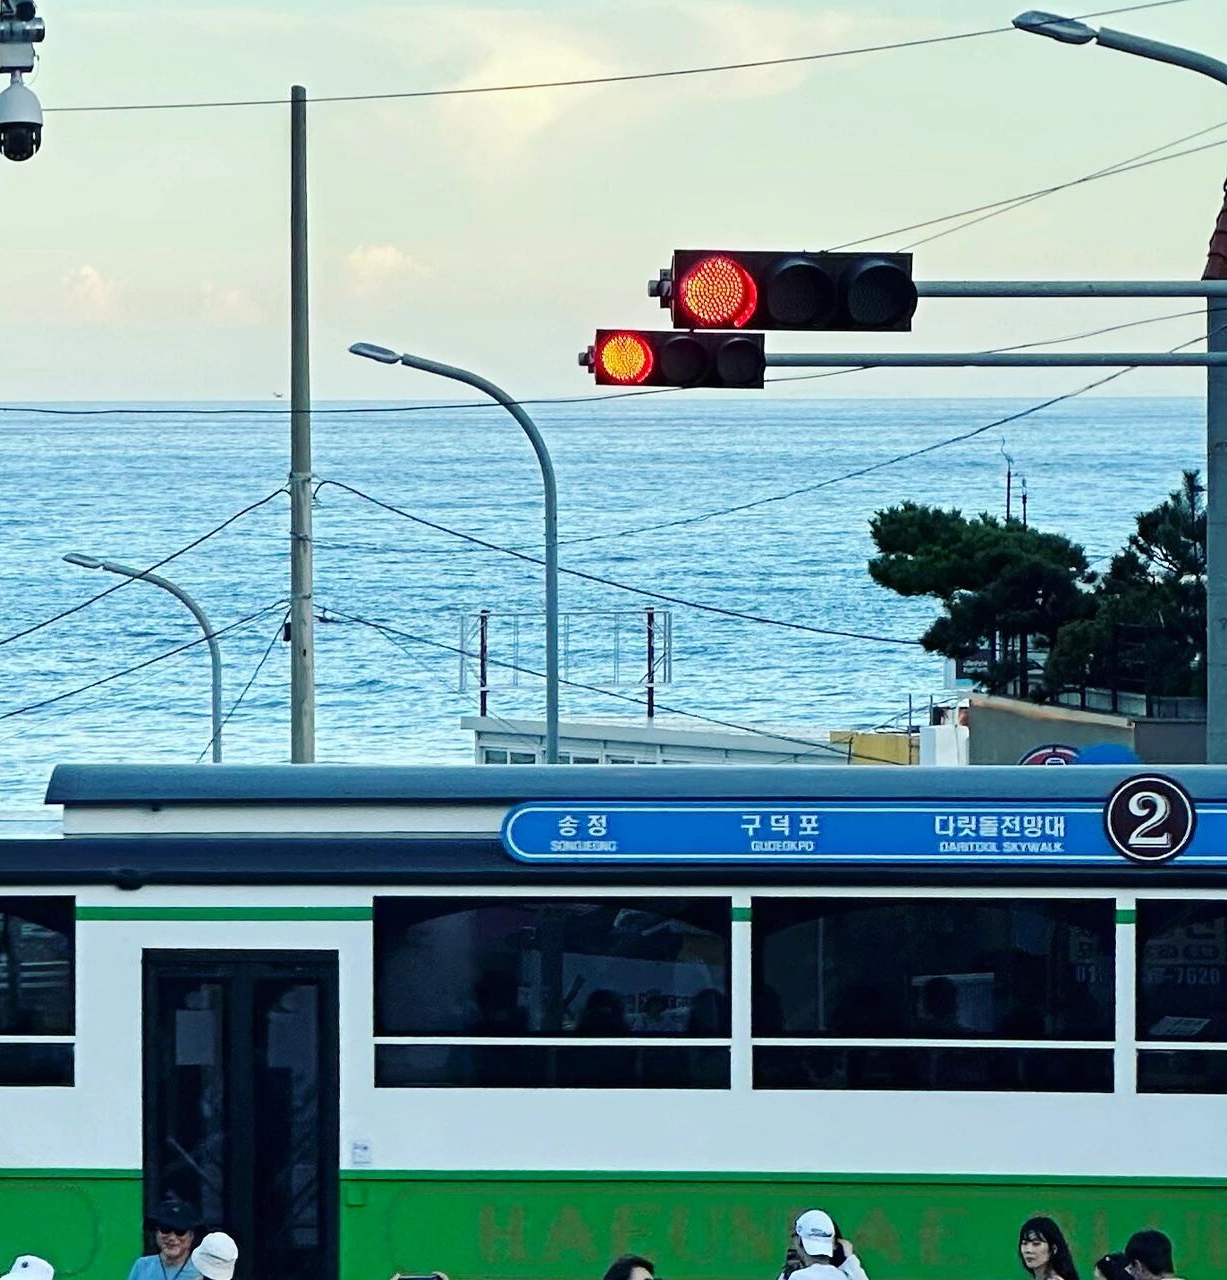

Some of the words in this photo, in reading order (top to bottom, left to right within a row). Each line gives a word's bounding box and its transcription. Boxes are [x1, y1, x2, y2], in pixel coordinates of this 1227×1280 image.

[740, 814, 820, 837] 구덕포
[934, 815, 1066, 838] 다릿돌전망대
[1128, 791, 1171, 848] 2
